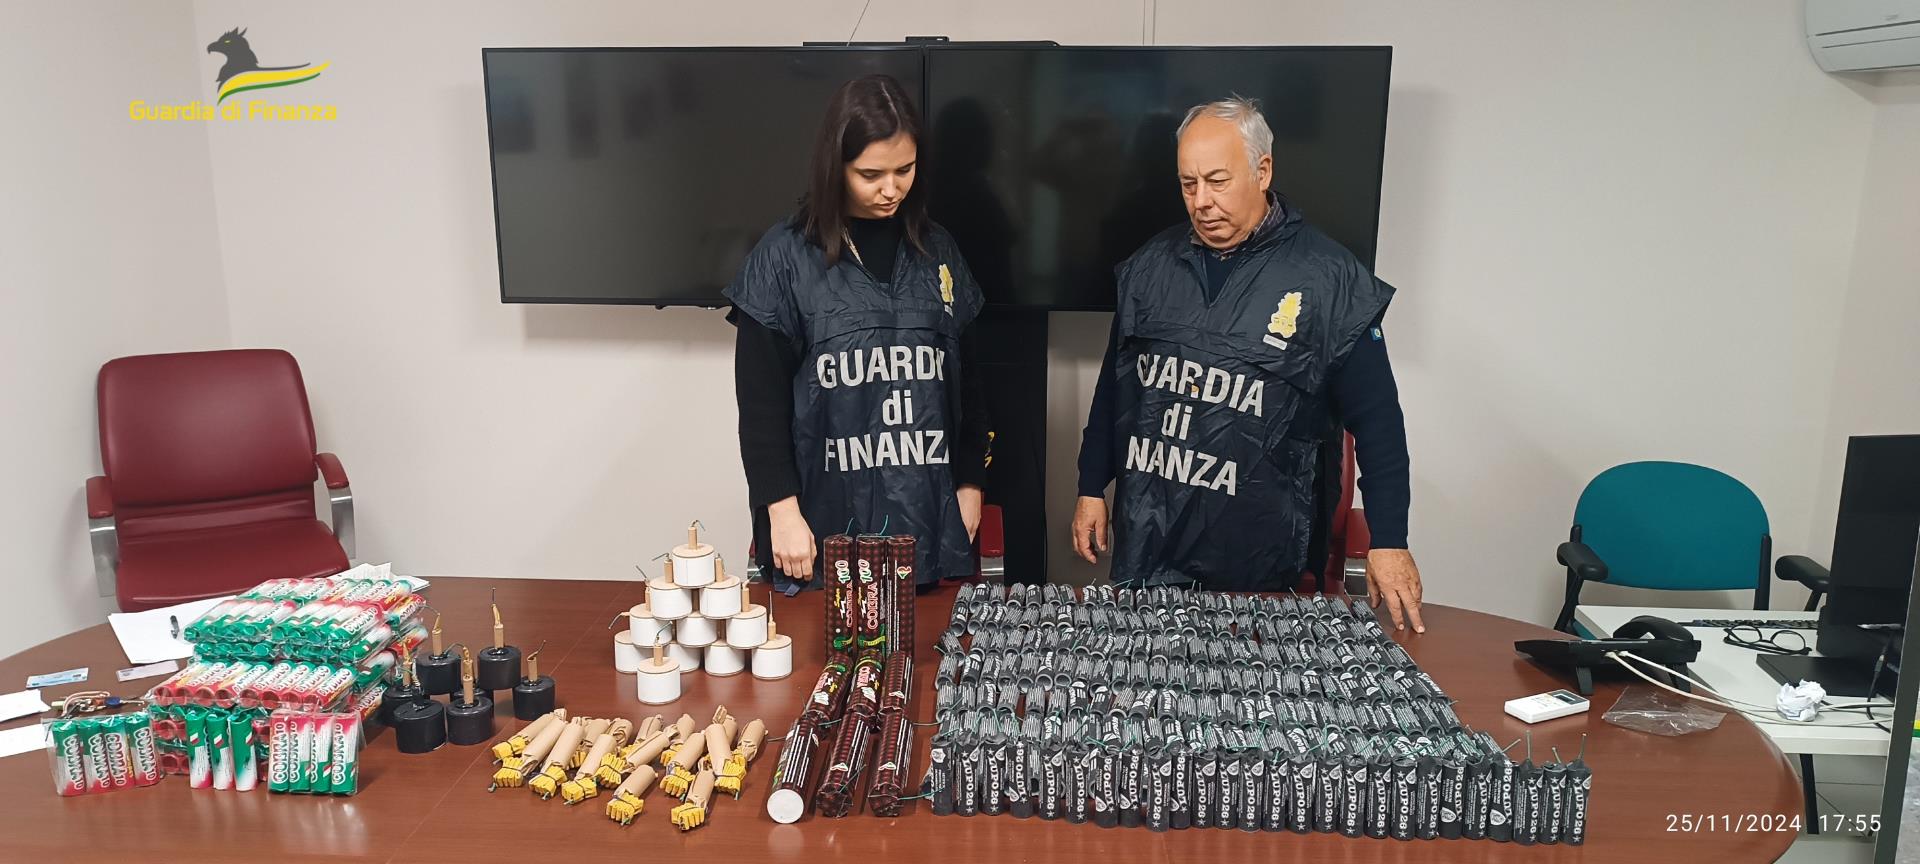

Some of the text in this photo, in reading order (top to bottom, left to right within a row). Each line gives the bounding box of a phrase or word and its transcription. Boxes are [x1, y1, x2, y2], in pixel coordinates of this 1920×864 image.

[882, 389, 914, 426] di
[1161, 402, 1193, 441] di
[834, 559, 851, 584] 100
[857, 558, 879, 630] COBRA 100
